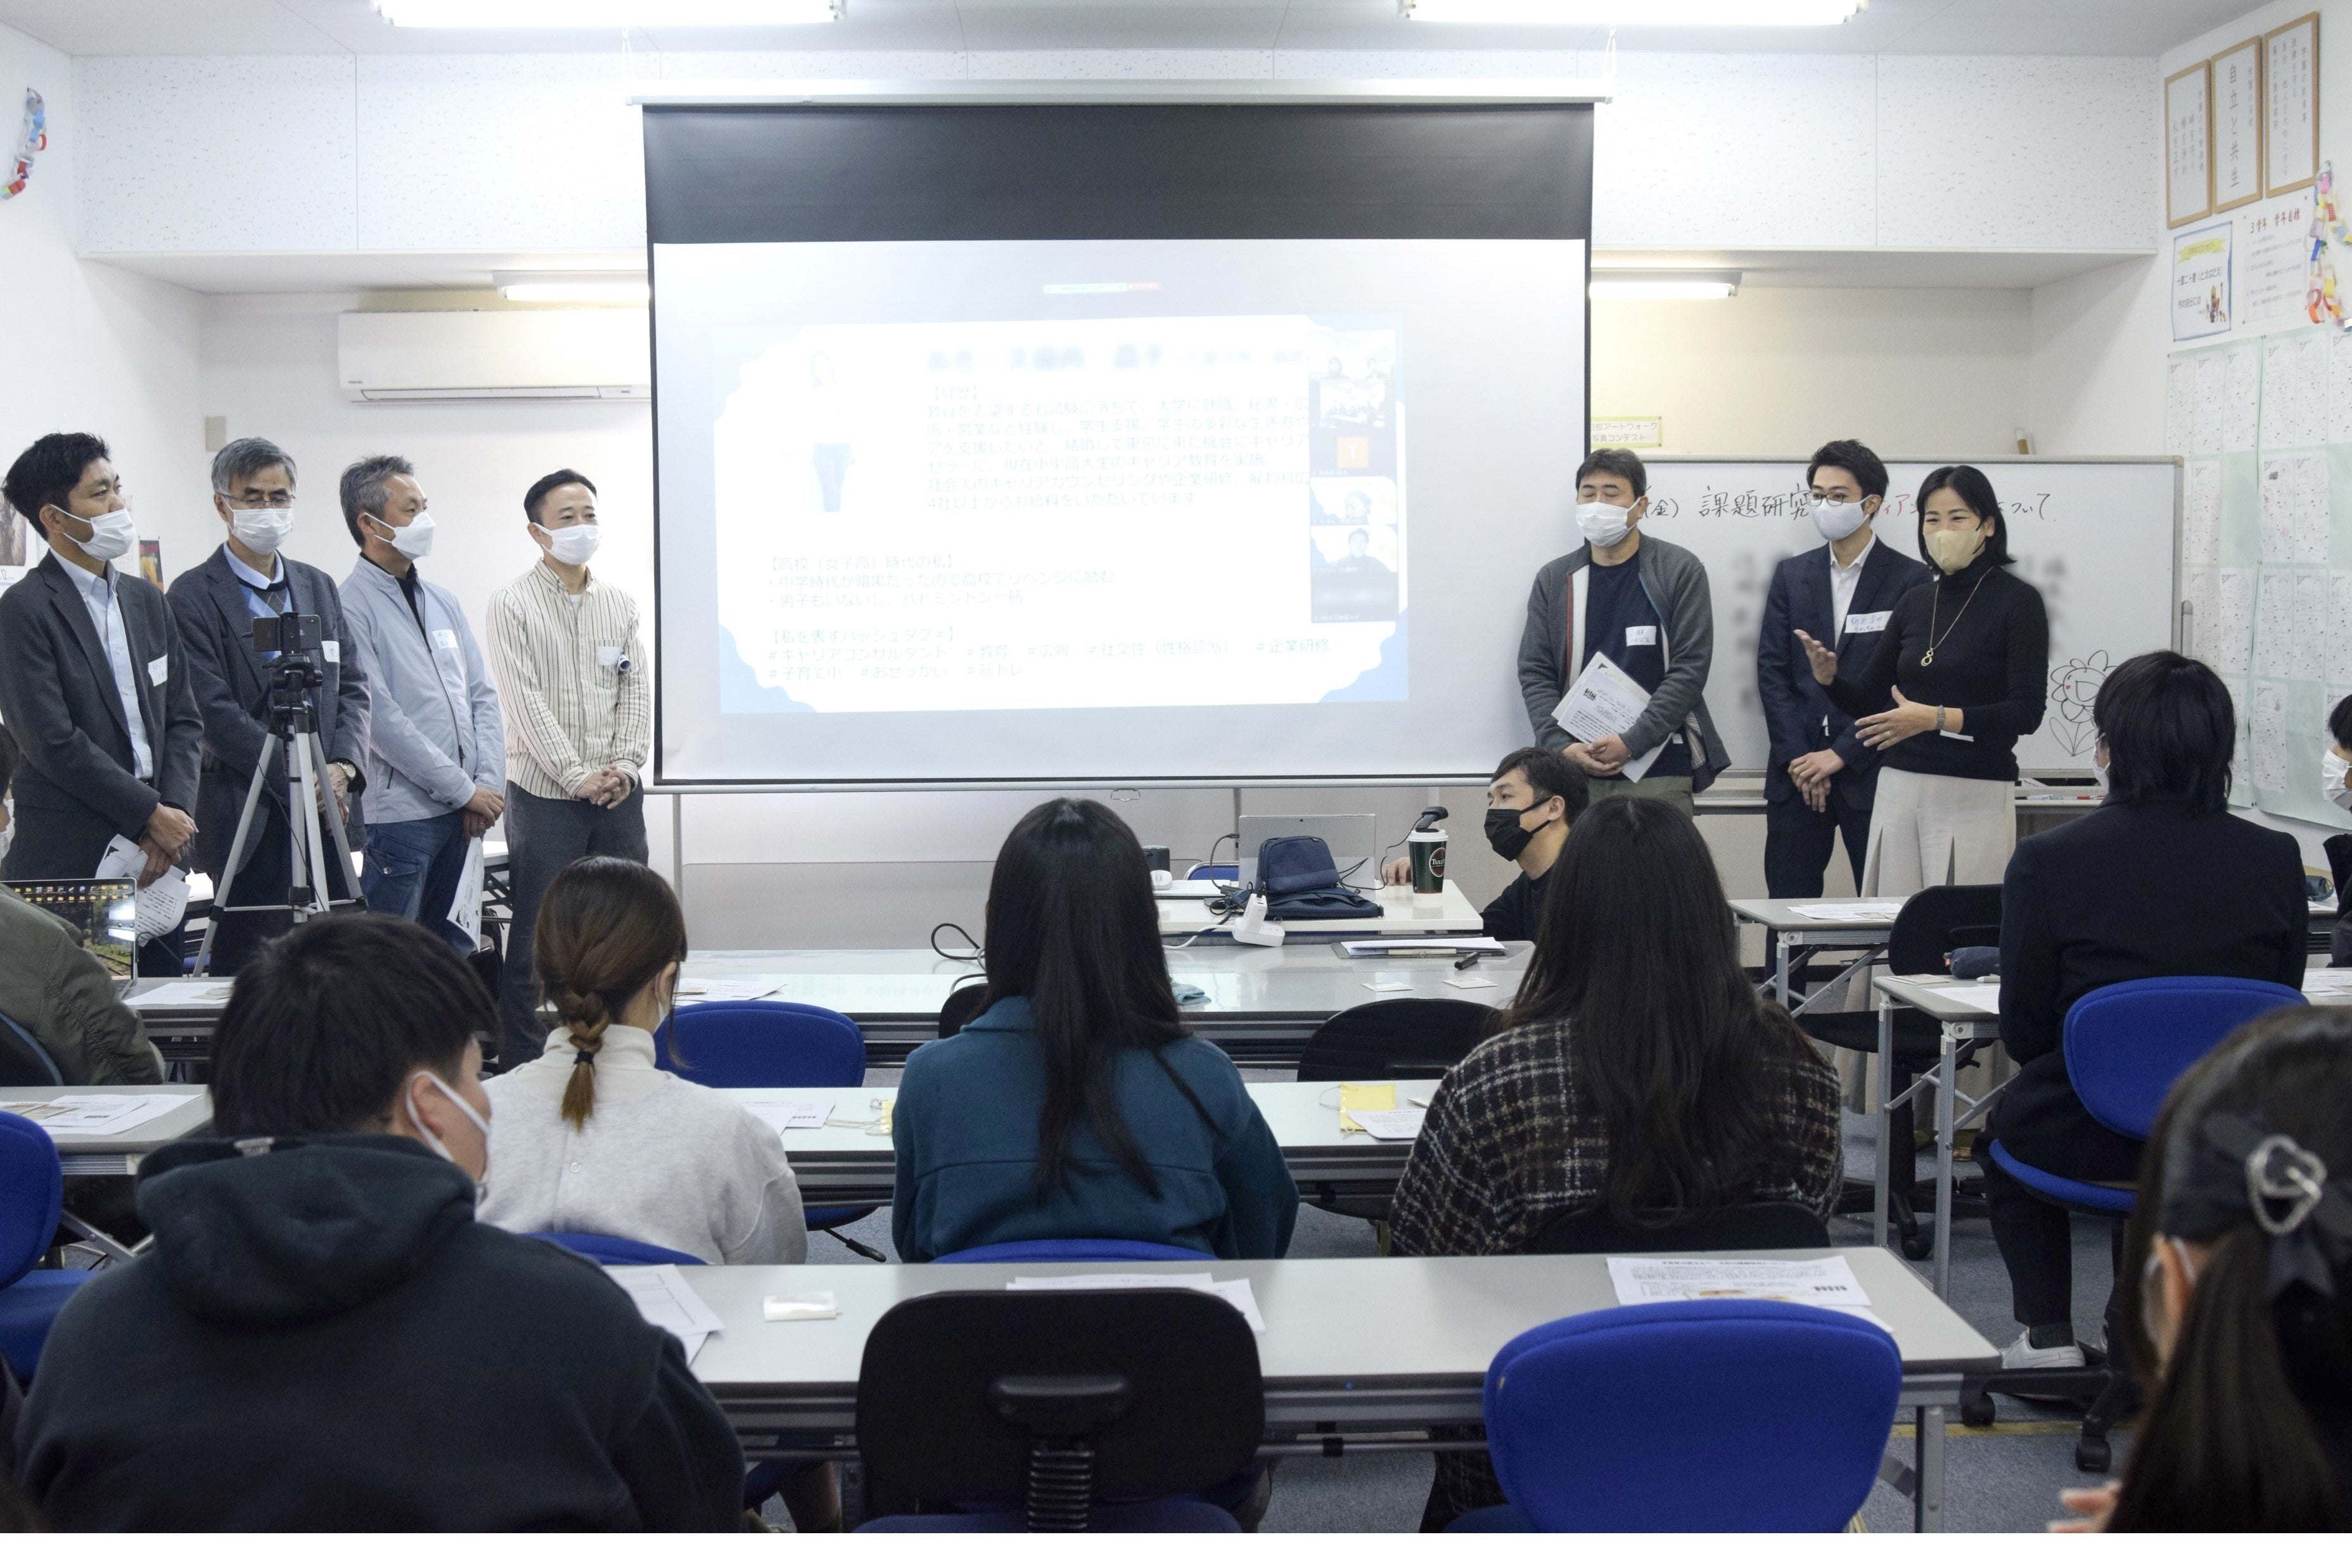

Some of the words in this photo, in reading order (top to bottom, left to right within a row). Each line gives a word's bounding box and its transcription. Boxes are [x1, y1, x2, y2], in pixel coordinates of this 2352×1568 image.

[2230, 61, 2239, 188] 自立と共生
[1592, 434, 1646, 442] 写真コンテスト
[1699, 483, 1811, 520] 課題研究
